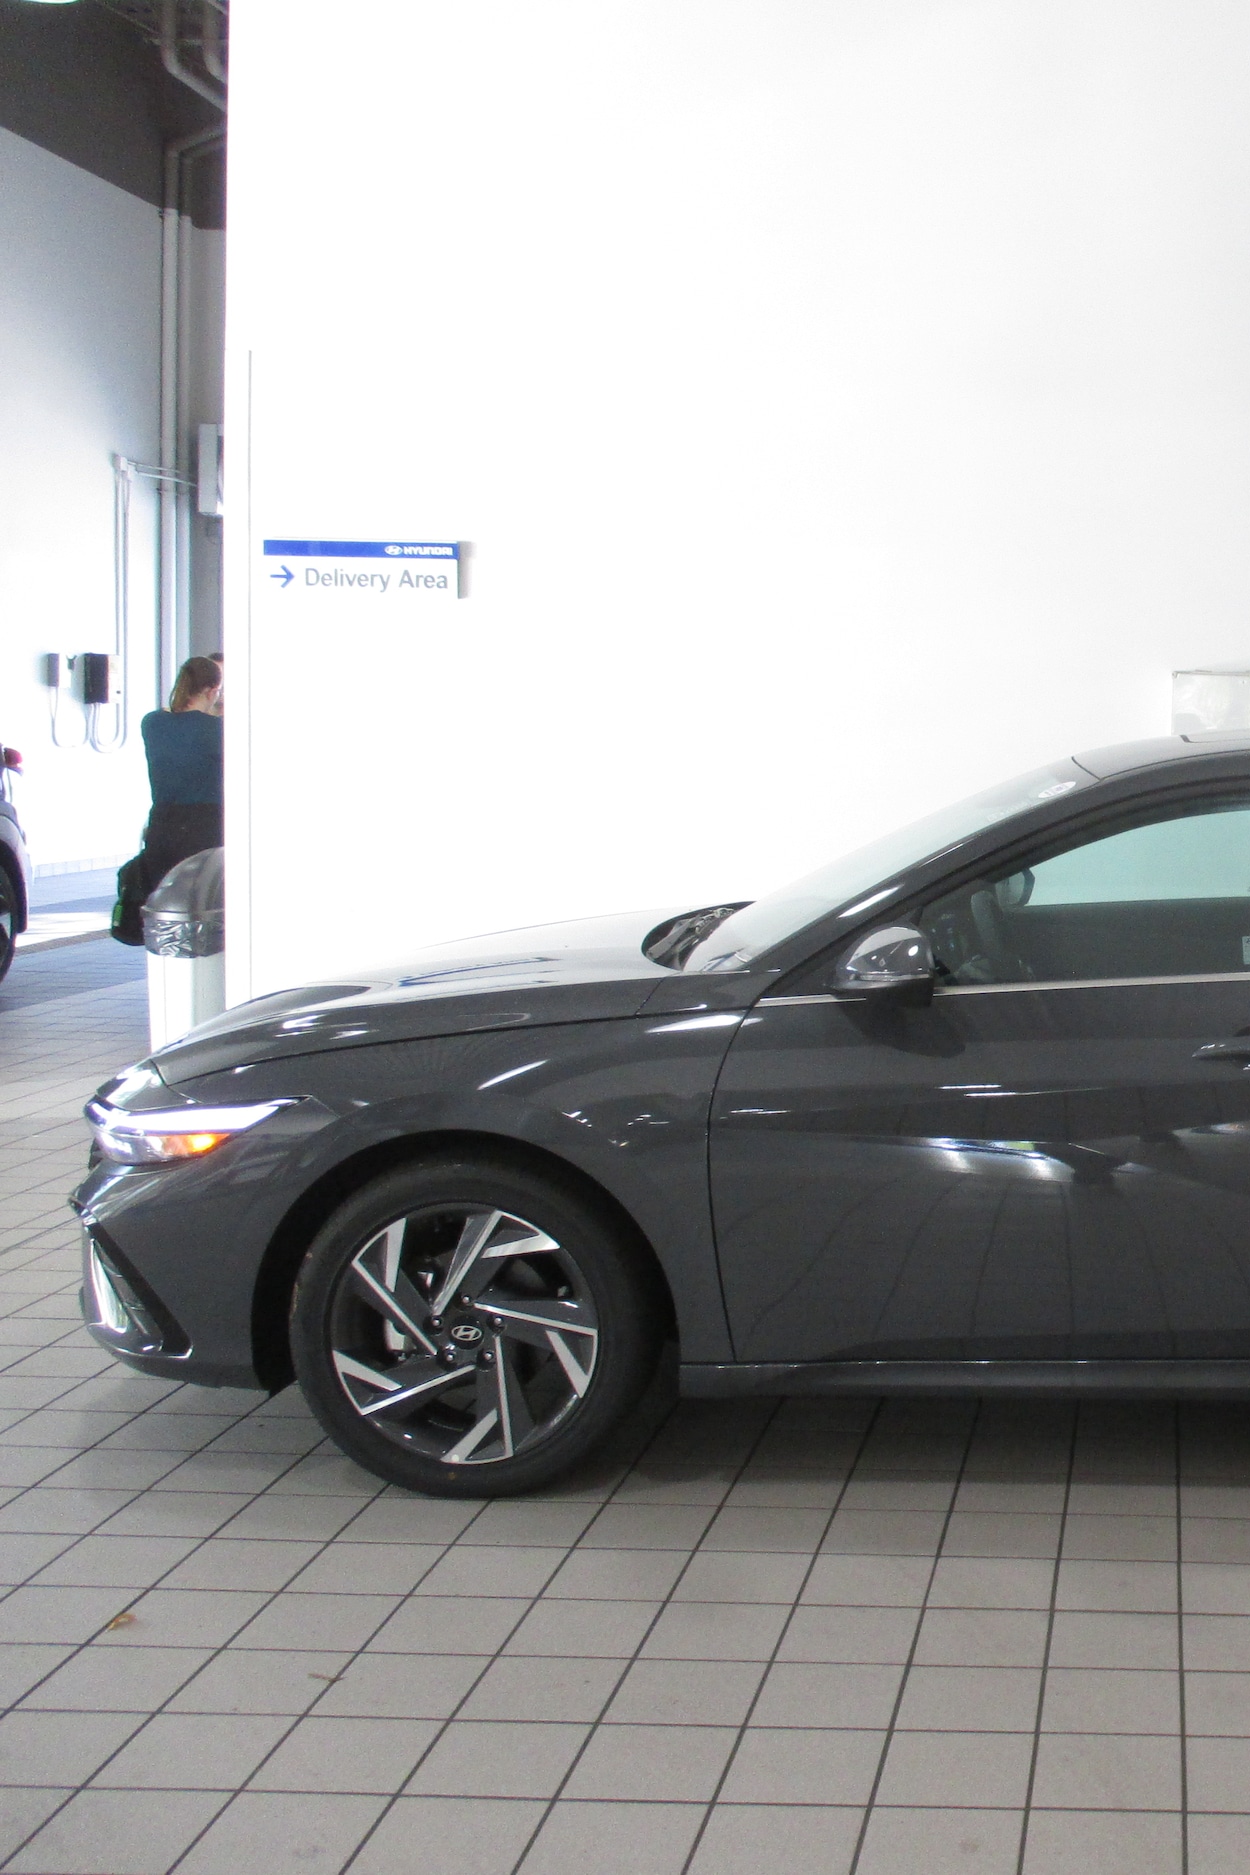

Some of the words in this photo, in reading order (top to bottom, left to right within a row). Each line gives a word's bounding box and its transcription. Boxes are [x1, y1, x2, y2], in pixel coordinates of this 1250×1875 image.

[403, 545, 453, 556] HYUNDAI
[304, 567, 391, 593] Delivery
[398, 569, 449, 589] Area
